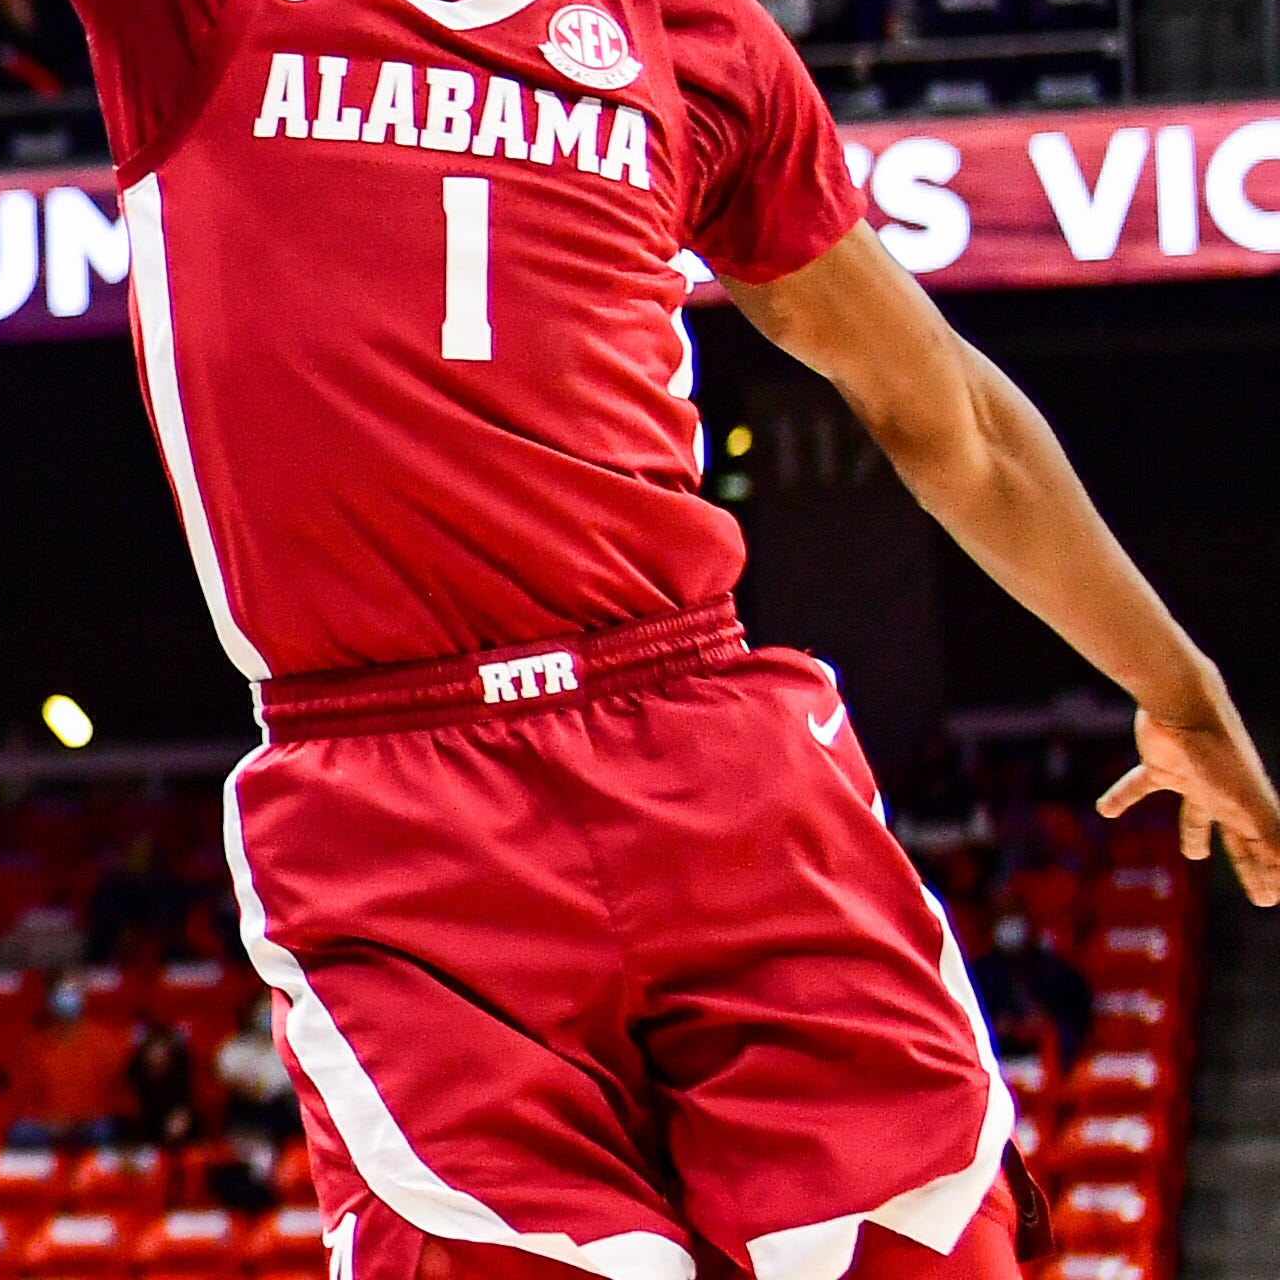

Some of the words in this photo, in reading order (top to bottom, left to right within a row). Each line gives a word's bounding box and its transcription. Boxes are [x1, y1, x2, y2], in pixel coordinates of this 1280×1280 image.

[555, 10, 622, 69] SEC
[253, 52, 651, 191] ALABAMA
[441, 176, 493, 362] 1
[478, 651, 578, 703] RTR
